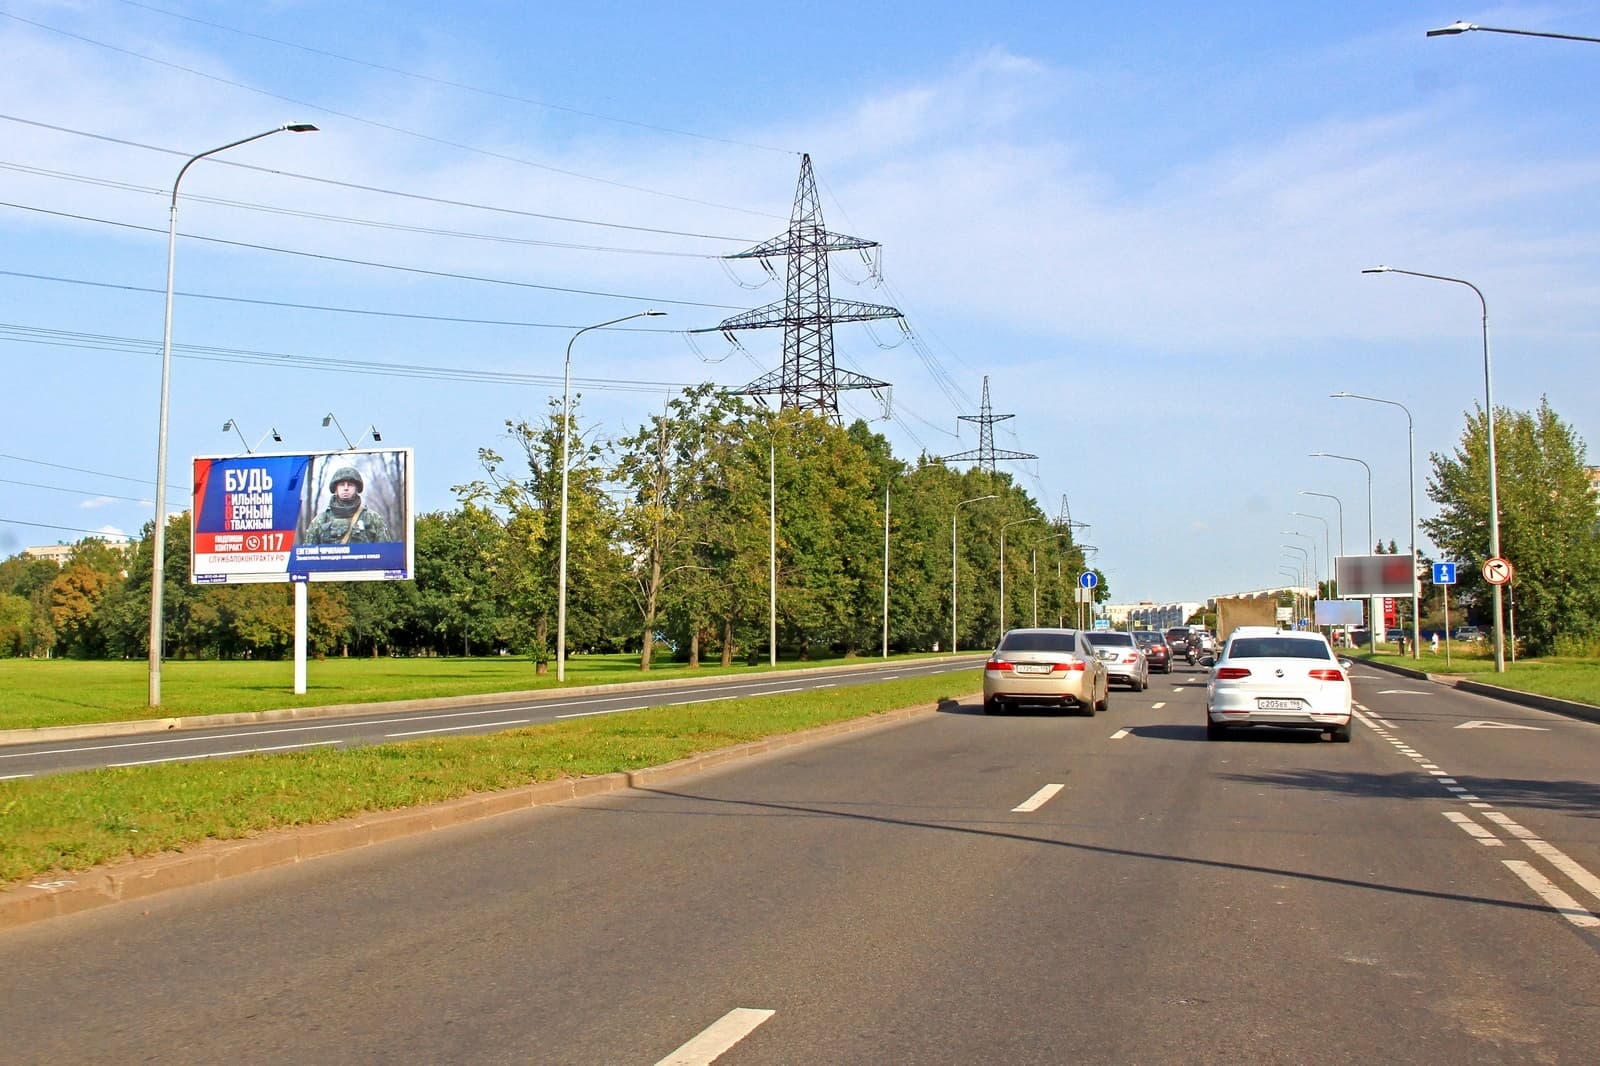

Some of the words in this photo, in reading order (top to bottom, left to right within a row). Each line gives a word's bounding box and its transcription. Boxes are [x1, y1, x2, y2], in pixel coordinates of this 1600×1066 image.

[225, 468, 273, 493] БУДЬ
[225, 492, 273, 506] СИЛЬНЫМ
[225, 505, 273, 520] ВЕРНЫМ
[224, 518, 273, 531] ОТВАЖНЫМ
[214, 543, 243, 552] КОНТРАКТ
[262, 533, 284, 551] 117
